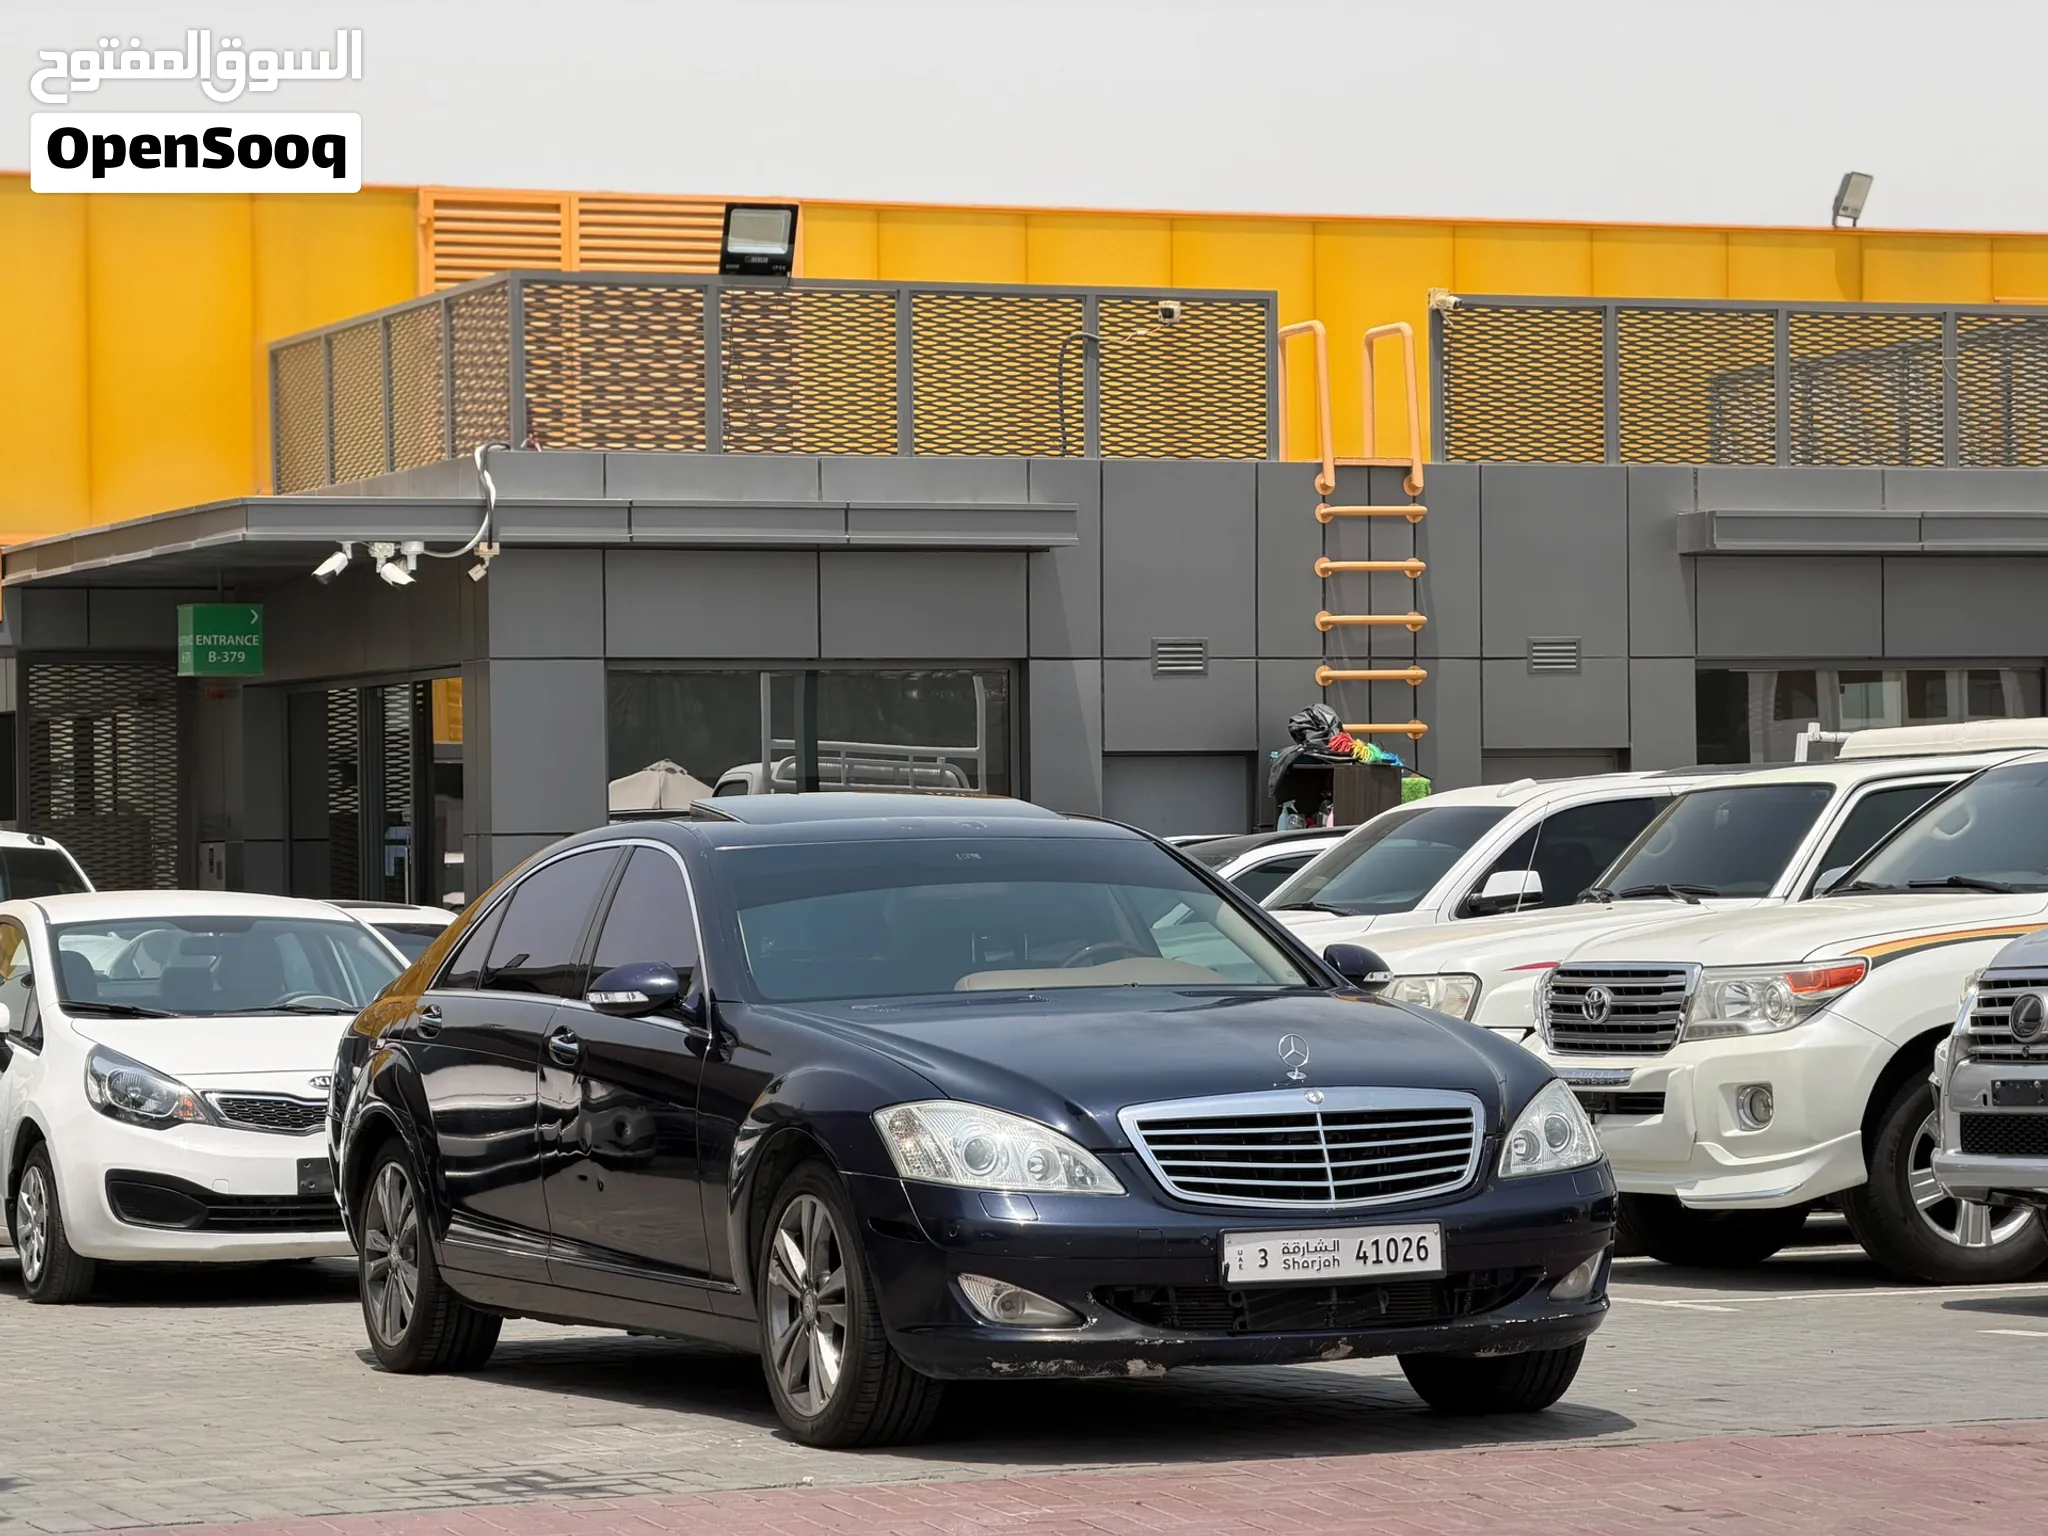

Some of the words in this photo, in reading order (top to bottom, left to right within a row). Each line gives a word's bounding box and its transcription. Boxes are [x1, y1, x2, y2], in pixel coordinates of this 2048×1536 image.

[196, 634, 259, 646] ENTRANCE
[208, 651, 246, 663] B-379
[1281, 1238, 1340, 1257] الشارقة
[1355, 1235, 1430, 1265] 41026
[1257, 1248, 1269, 1268] 3
[1282, 1255, 1341, 1271] Sharjah
